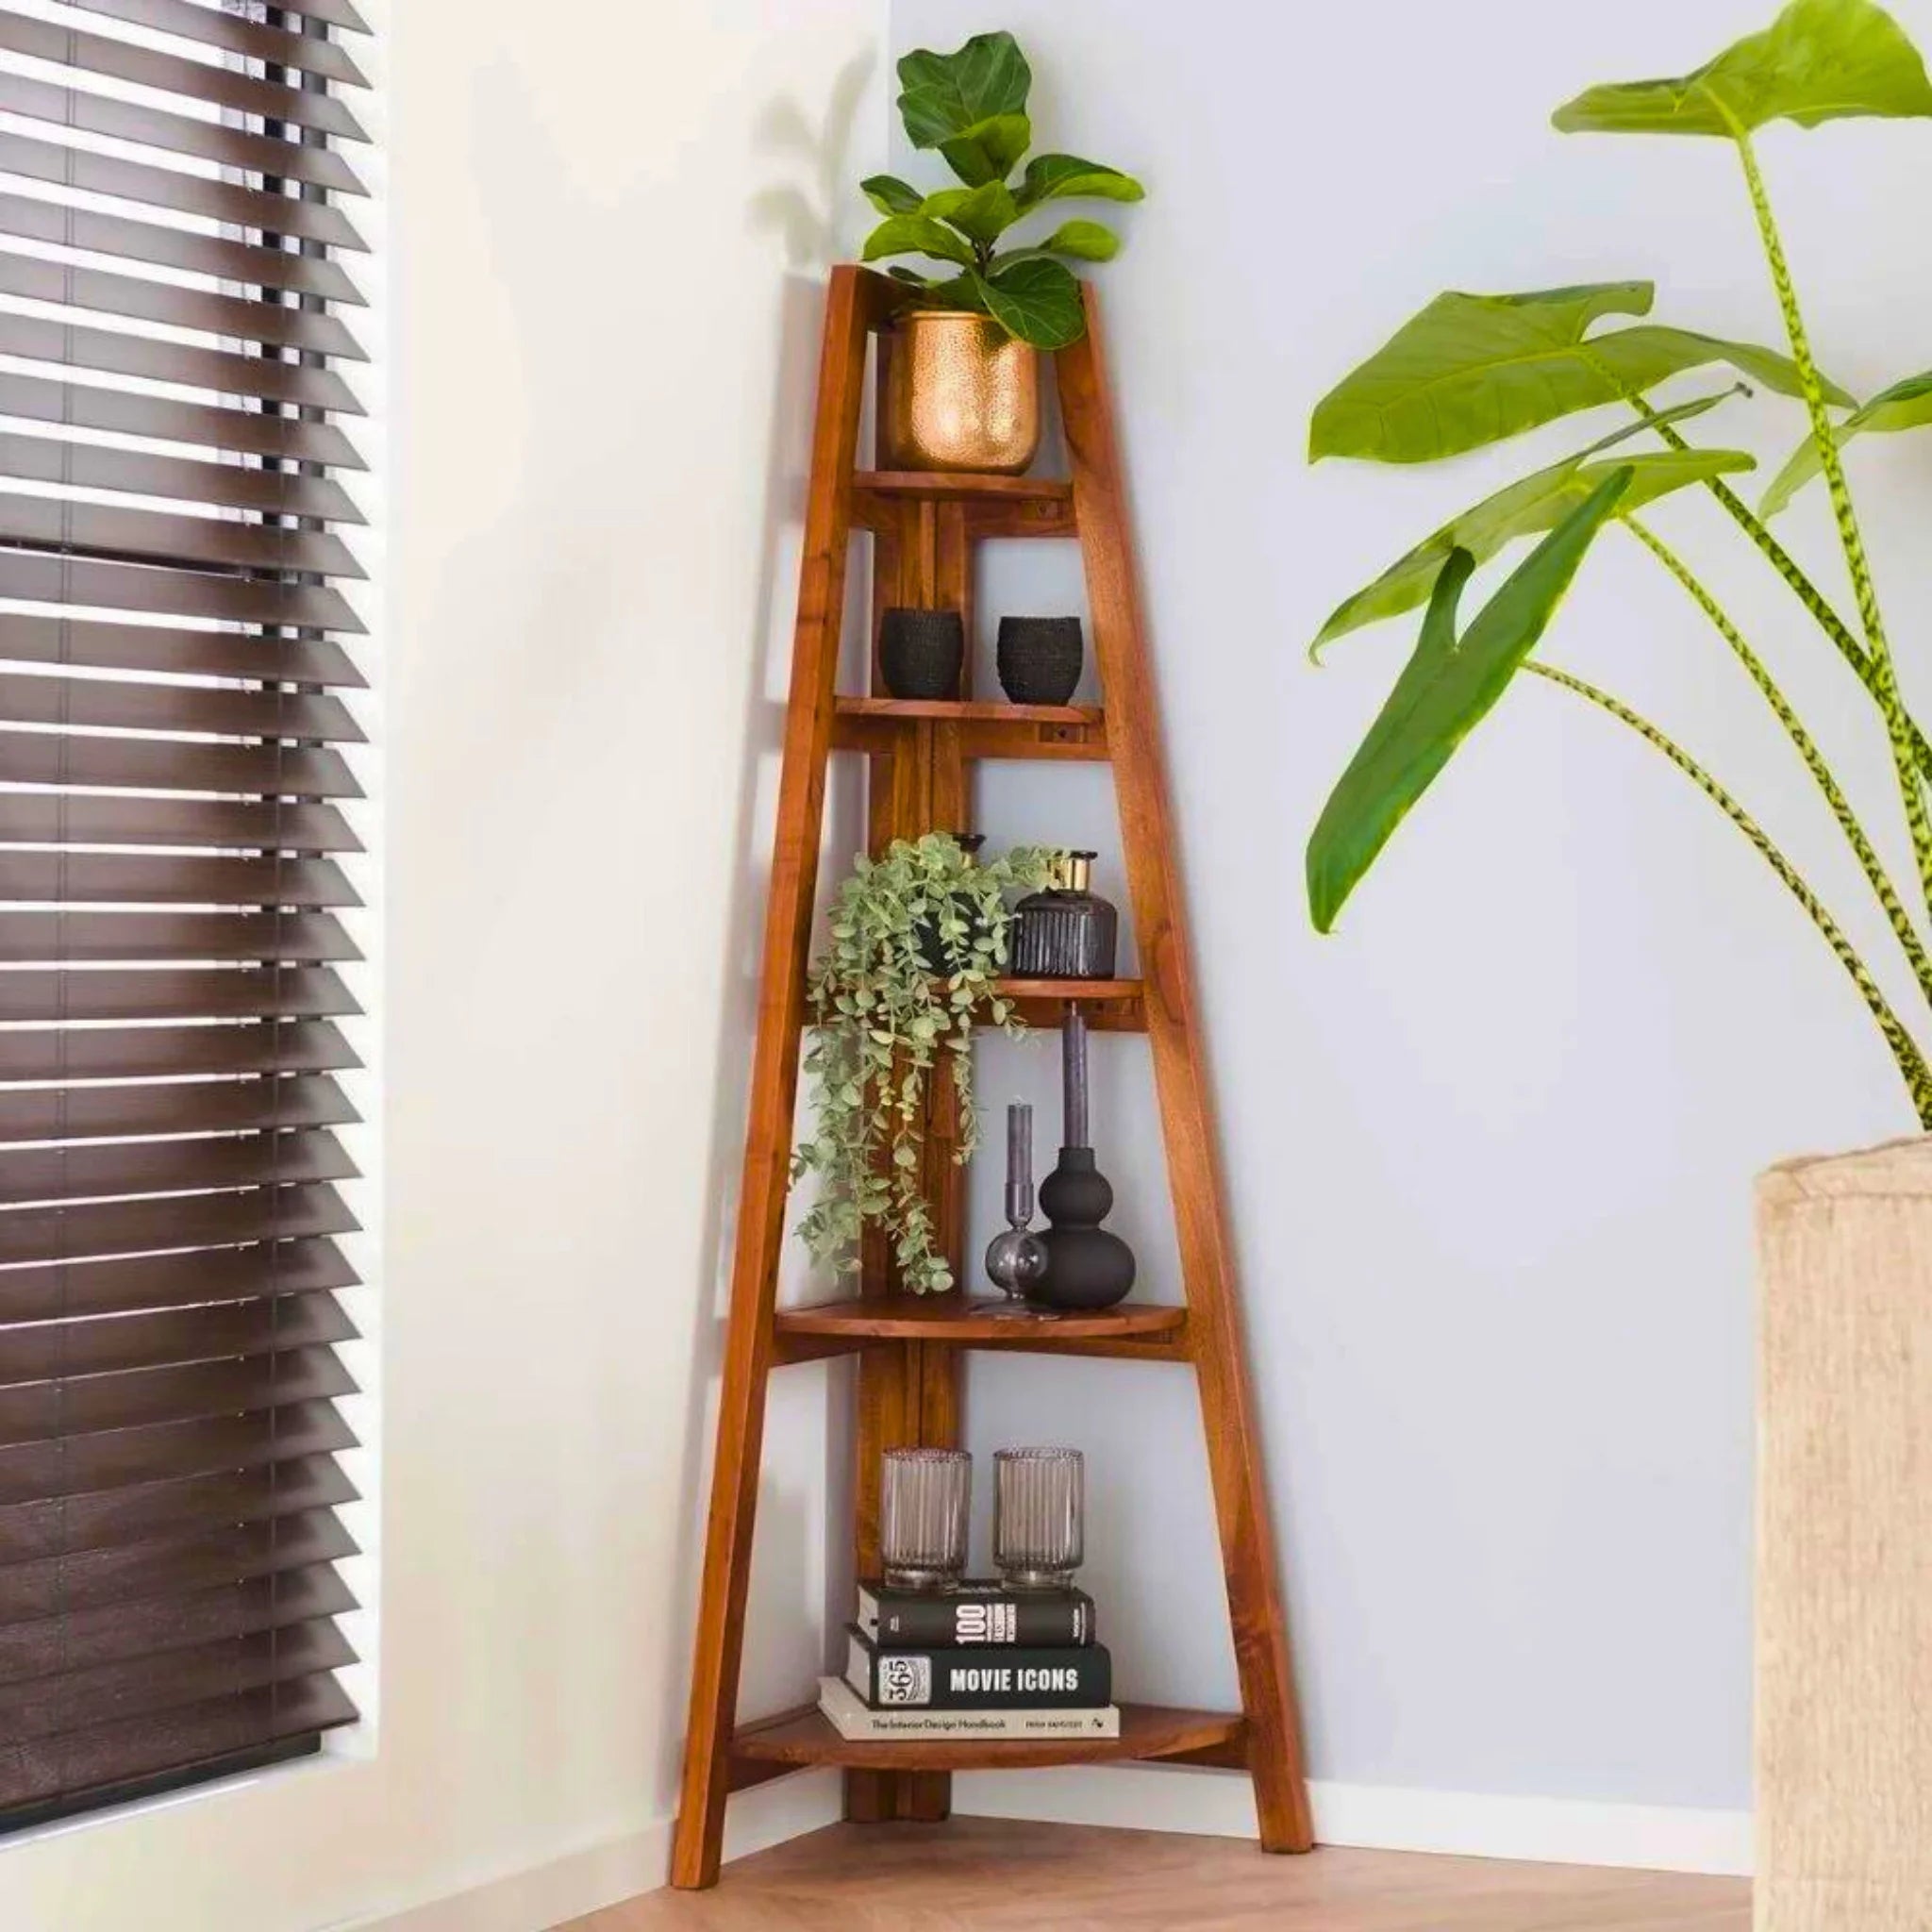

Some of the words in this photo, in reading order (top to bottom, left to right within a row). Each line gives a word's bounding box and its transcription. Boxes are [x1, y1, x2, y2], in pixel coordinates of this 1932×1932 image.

[956, 1605, 986, 1644] 100
[889, 1660, 911, 1700] 365
[950, 1669, 1011, 1691] MOVIE
[1018, 1669, 1078, 1691] ICONS
[873, 1719, 888, 1729] The
[924, 1719, 957, 1730] Design
